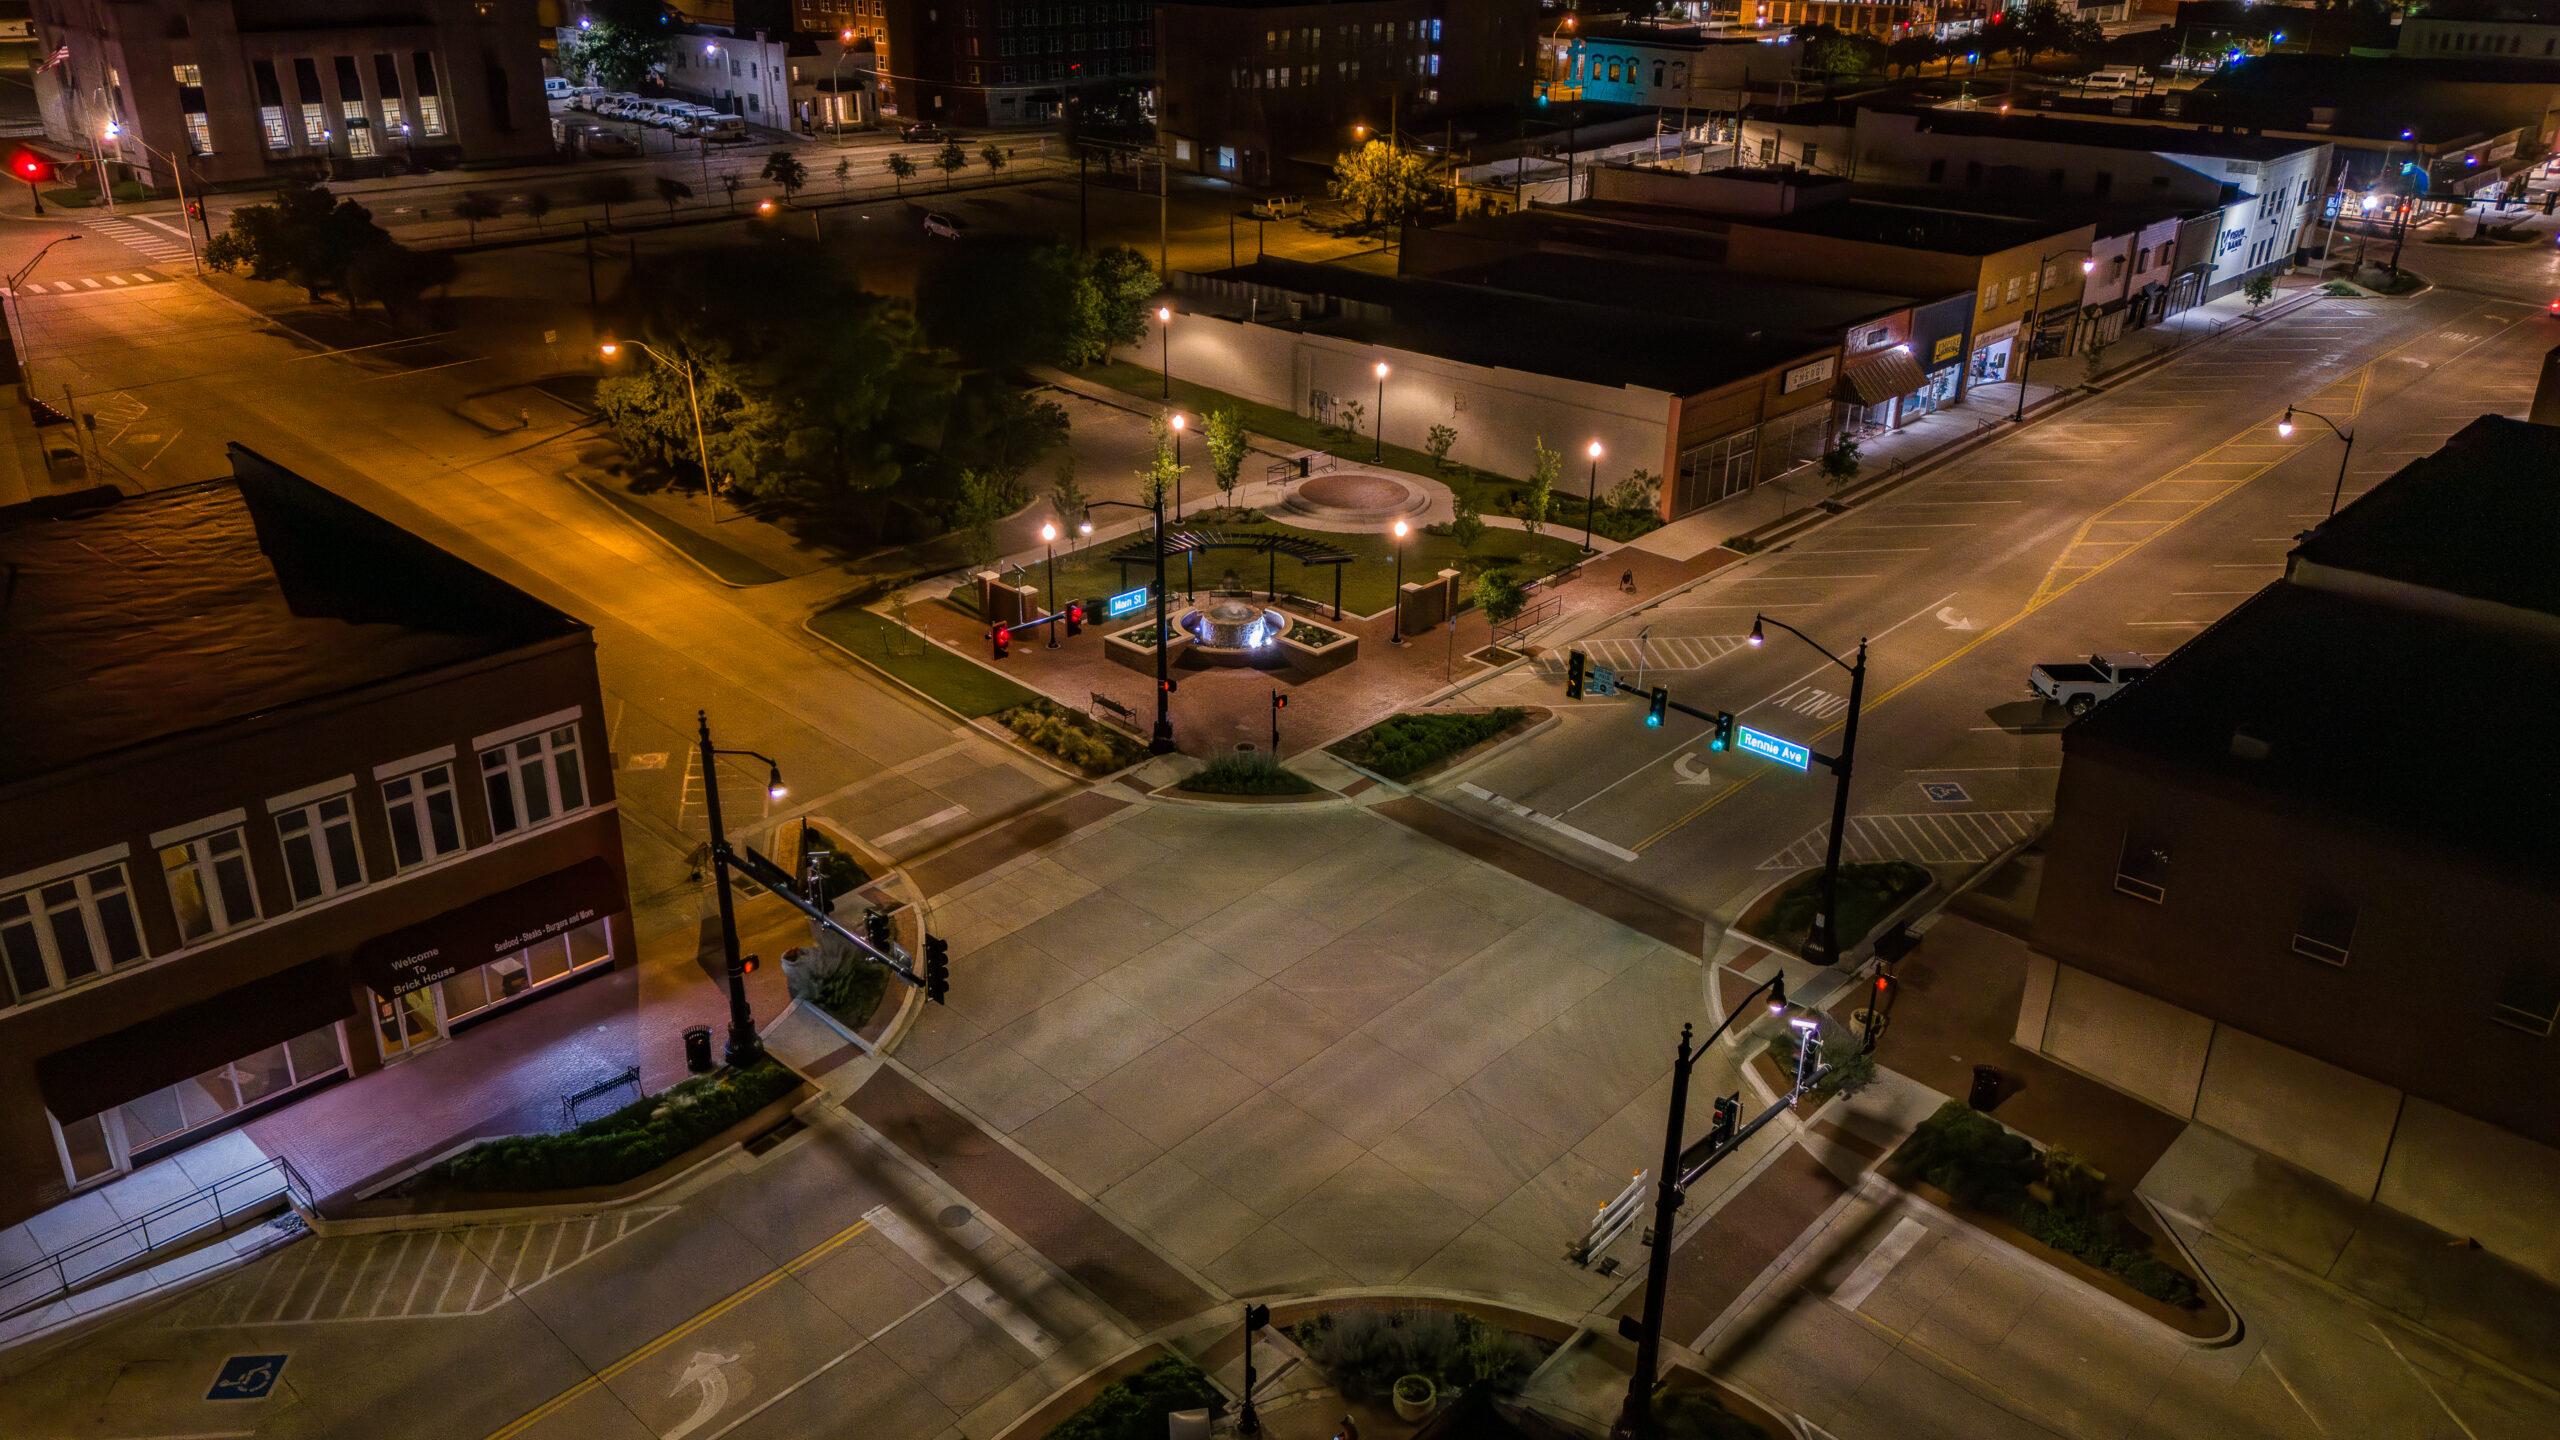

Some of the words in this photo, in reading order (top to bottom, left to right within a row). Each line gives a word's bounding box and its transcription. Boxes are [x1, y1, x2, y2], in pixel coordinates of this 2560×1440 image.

[2227, 238, 2243, 250] BANK
[1115, 599, 1132, 611] Main
[1133, 594, 1142, 605] St
[1772, 686, 1850, 719] ONLY
[1744, 733, 1780, 755] Rennie
[1781, 746, 1802, 763] Ave
[494, 936, 519, 952] Seafood
[522, 929, 543, 942] Steaks
[579, 908, 595, 920] More
[391, 948, 440, 971] Welcome
[413, 965, 427, 975] To
[393, 978, 421, 995] Brick
[422, 966, 455, 984] House
